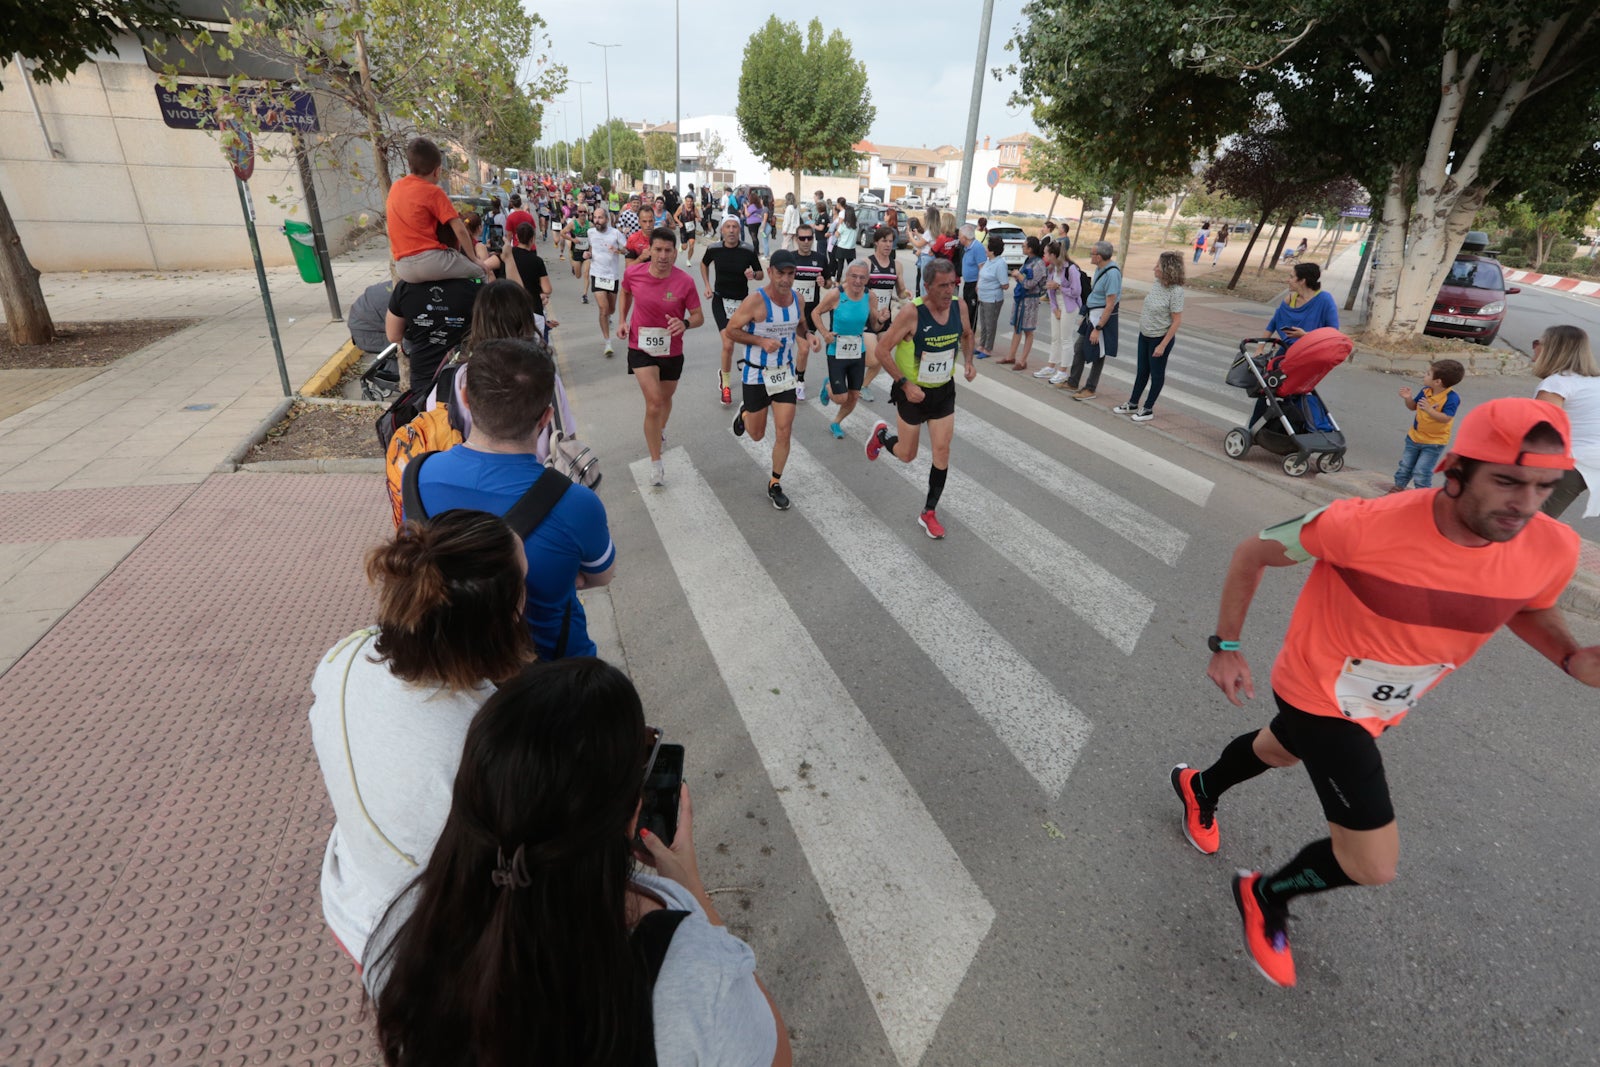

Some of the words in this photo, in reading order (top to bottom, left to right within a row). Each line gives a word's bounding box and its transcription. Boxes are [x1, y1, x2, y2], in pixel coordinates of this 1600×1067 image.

[645, 337, 665, 347] 595
[841, 343, 858, 351] 473
[928, 361, 947, 373] 671
[770, 371, 787, 384] 867
